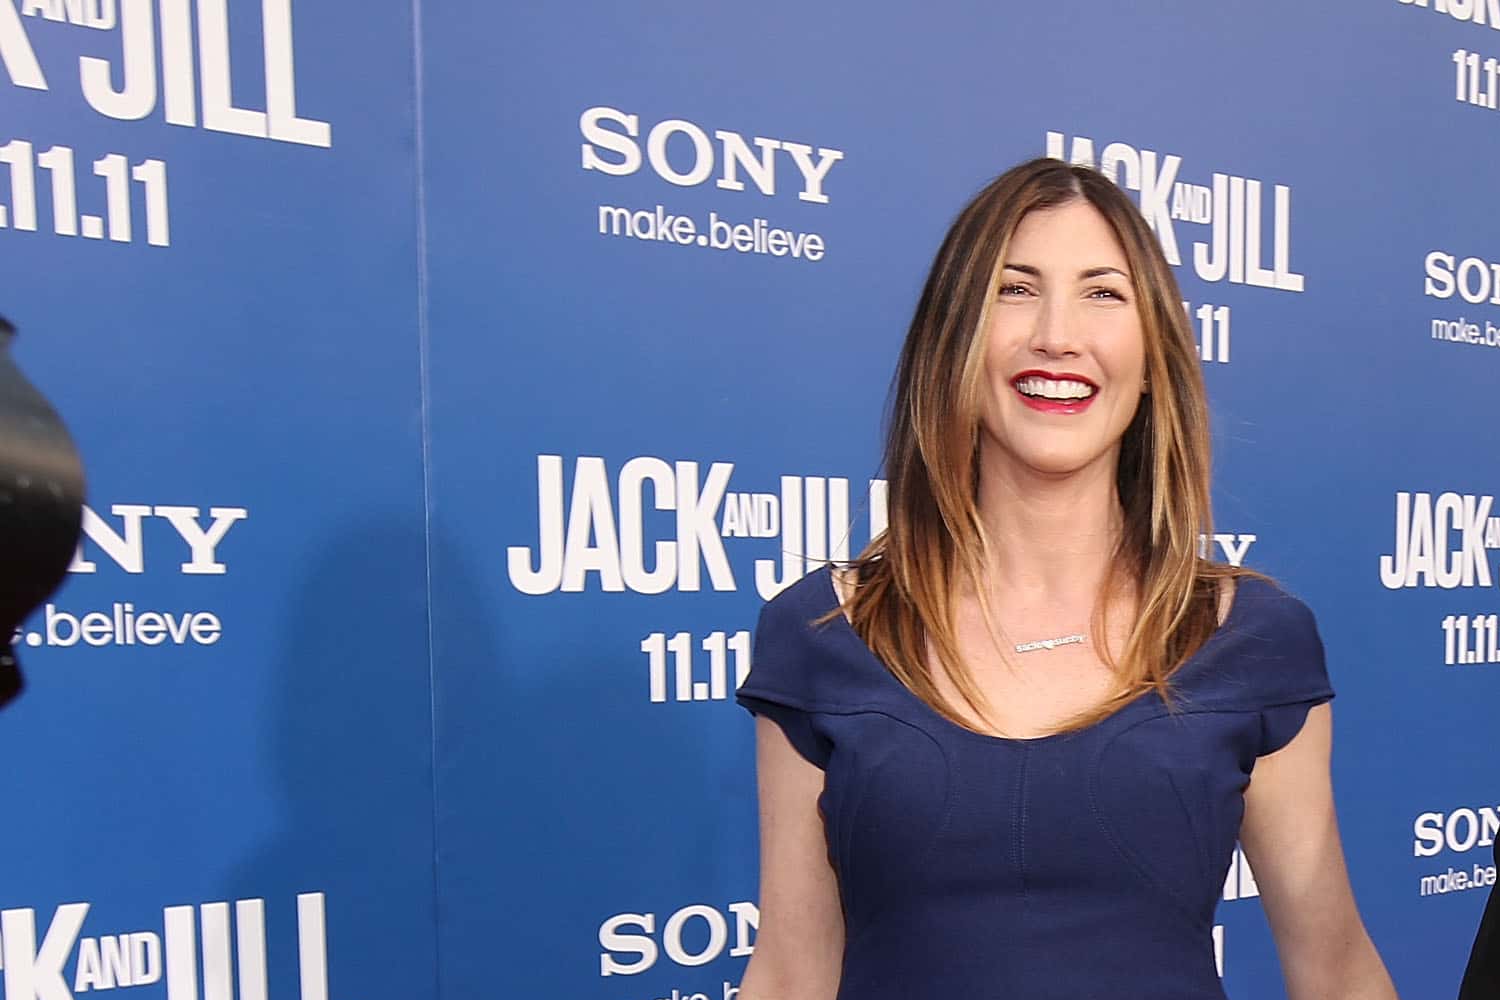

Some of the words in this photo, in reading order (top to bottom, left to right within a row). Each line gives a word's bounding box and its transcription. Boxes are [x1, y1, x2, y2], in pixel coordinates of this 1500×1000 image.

[79, 0, 332, 148] JILL
[0, 140, 170, 247] 11.11
[580, 106, 844, 204] SONY
[599, 205, 826, 261] make.believe
[1171, 182, 1212, 225] AND
[1193, 173, 1305, 292] JILL
[66, 504, 249, 574] NY
[507, 455, 737, 595] JACK
[721, 493, 780, 538] AND
[1380, 492, 1495, 590] JACK
[640, 631, 752, 703] 11.11
[1420, 863, 1497, 897] make.be
[74, 931, 163, 993] AND
